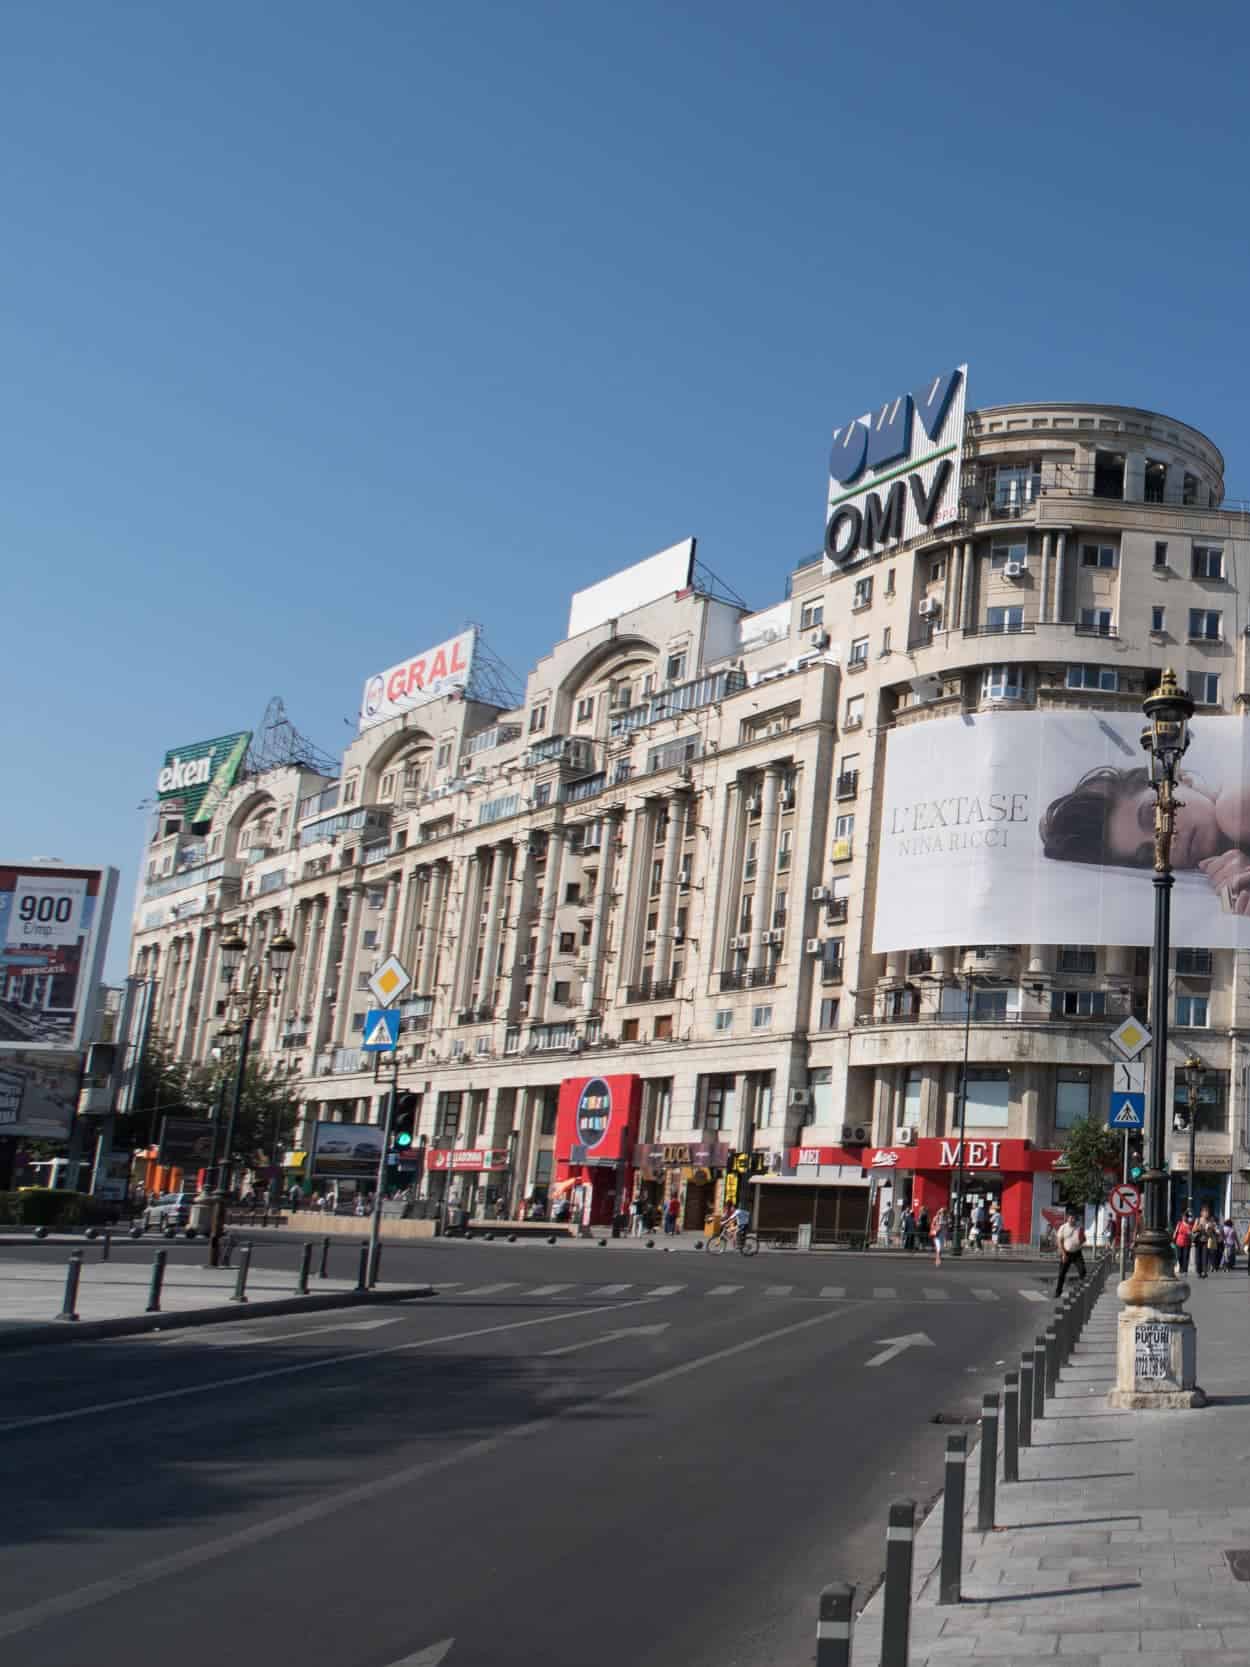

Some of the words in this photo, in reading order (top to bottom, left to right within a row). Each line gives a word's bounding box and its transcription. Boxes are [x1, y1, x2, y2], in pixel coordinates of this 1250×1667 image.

[824, 459, 953, 563] OMV
[387, 641, 467, 702] GRAL
[891, 793, 1029, 835] L'EXTASE
[899, 835, 943, 856] NINA
[950, 829, 1009, 851] RICCI
[19, 895, 73, 923] 900
[799, 1149, 820, 1165] MEI
[939, 1141, 1001, 1168] MEI
